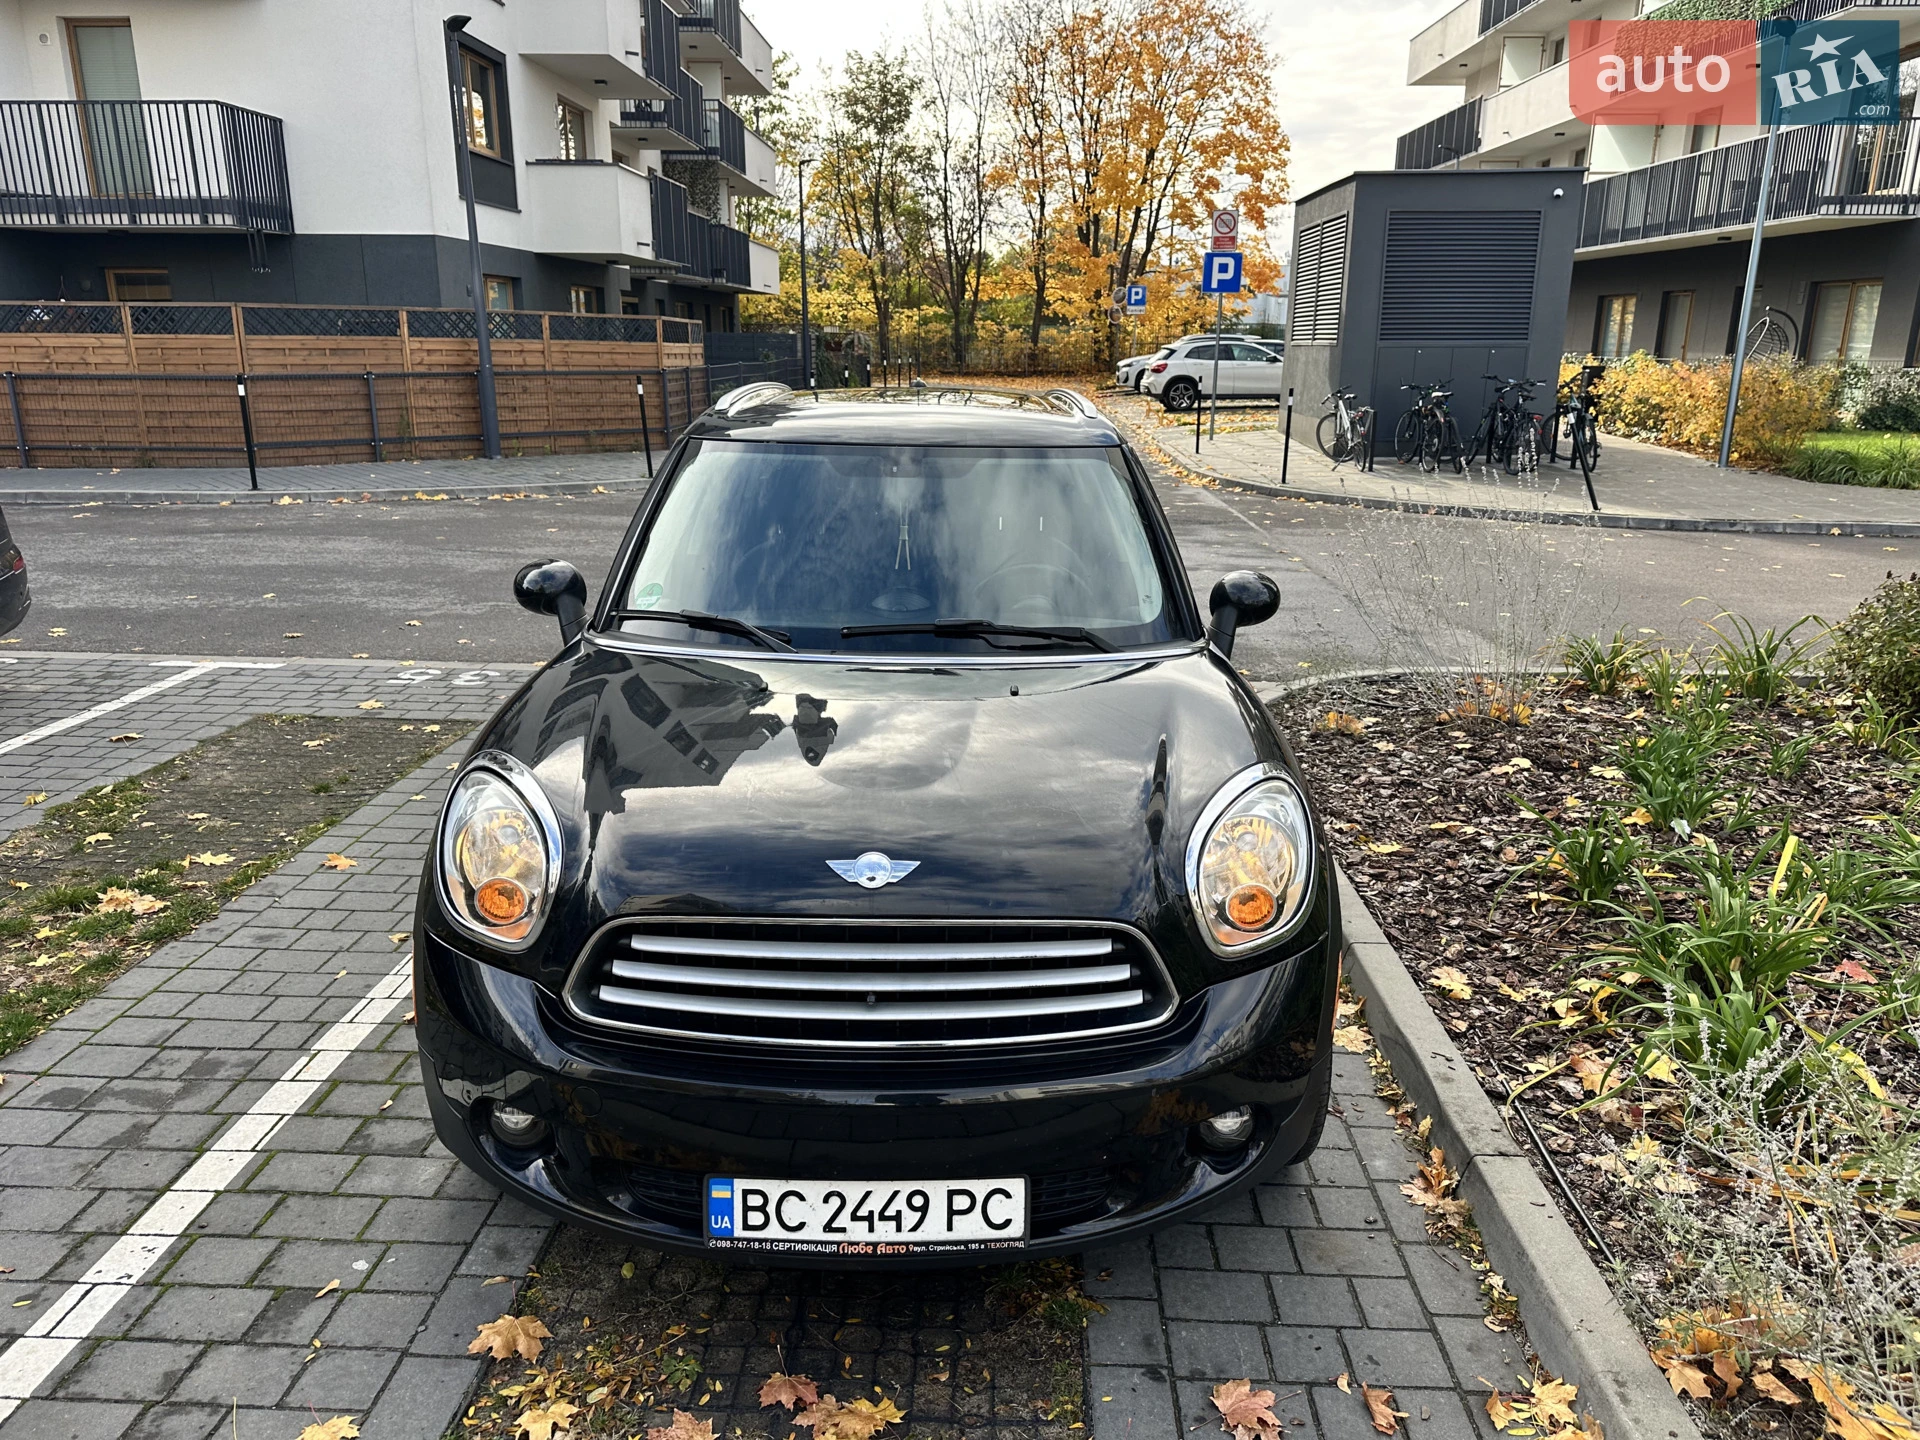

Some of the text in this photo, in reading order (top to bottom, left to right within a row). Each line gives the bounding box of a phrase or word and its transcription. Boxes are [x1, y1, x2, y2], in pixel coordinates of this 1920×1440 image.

[1211, 256, 1235, 289] P
[1131, 287, 1142, 304] P
[742, 1187, 1013, 1233] BC 2449 PC
[711, 1215, 731, 1229] UA
[716, 1240, 771, 1250] 098-747-18-18
[772, 1242, 838, 1253] СЕРТИФІКАЦІЯ
[839, 1242, 873, 1254] Любе
[877, 1243, 907, 1255] Авто
[987, 1241, 1025, 1249] ТЕХОГЛЯД
